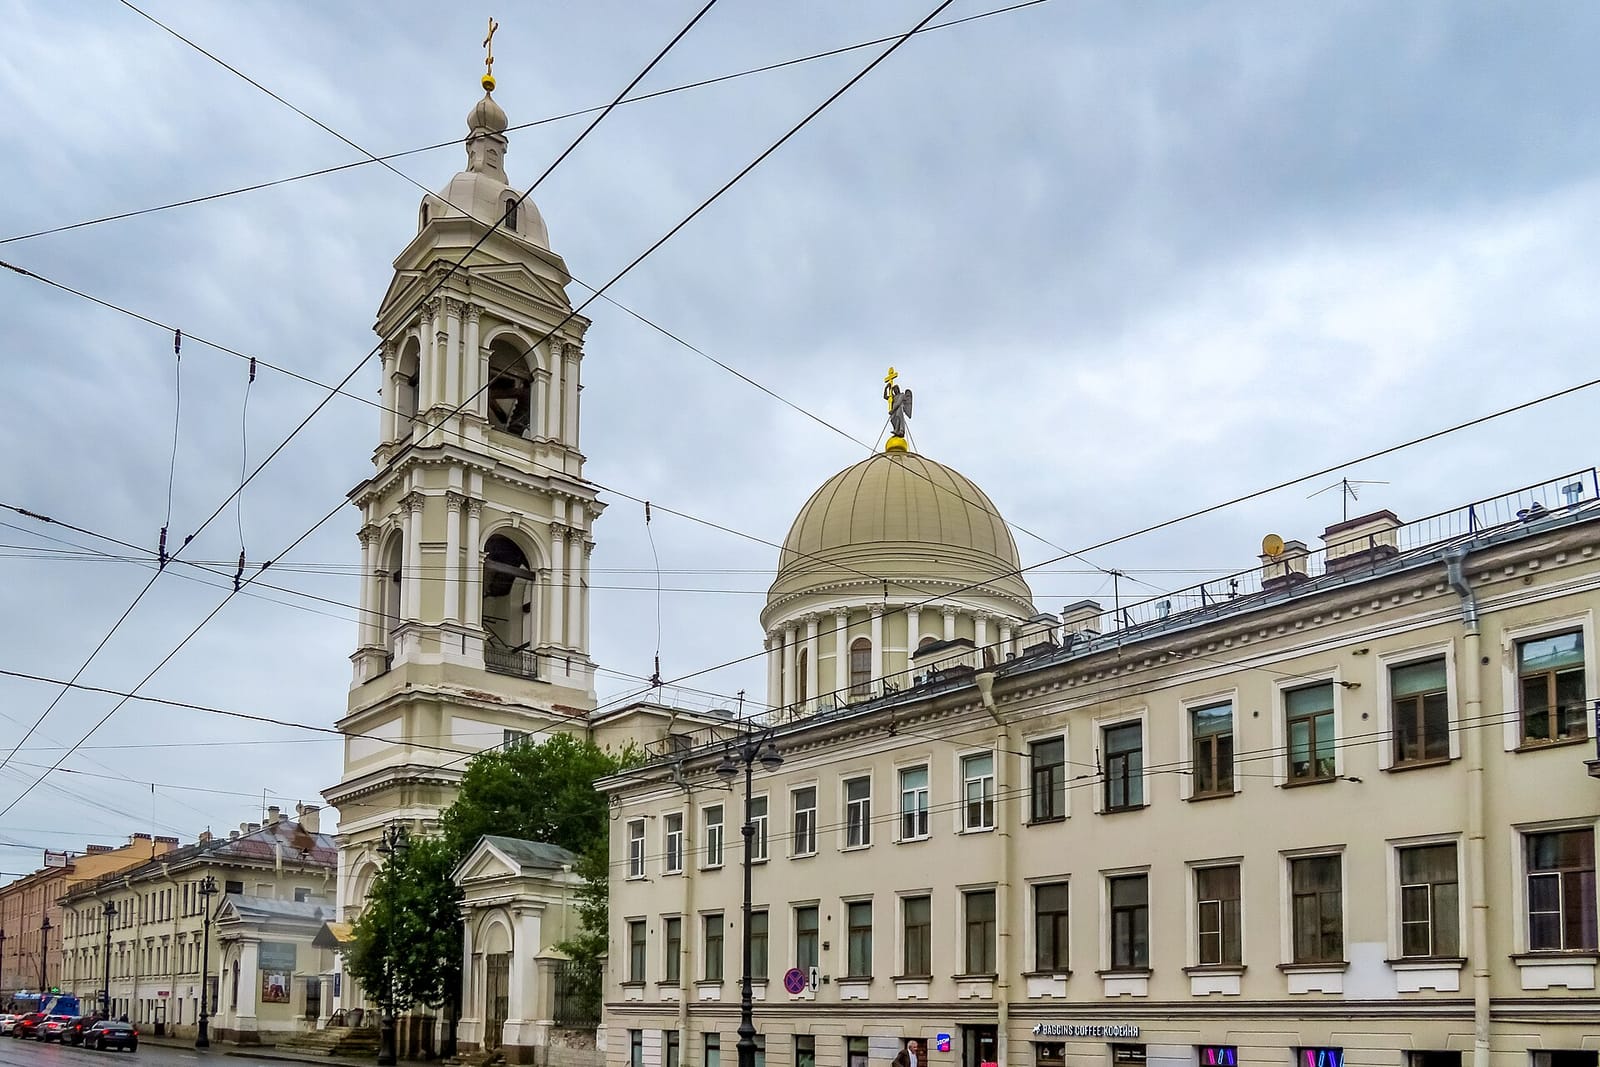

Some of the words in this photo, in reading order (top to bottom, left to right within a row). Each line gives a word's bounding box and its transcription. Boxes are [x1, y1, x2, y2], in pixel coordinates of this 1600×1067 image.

[1042, 1024, 1073, 1036] BAGGINS
[1075, 1025, 1101, 1036] COFFEE
[1103, 1023, 1139, 1037] КОФЕЙНЯ
